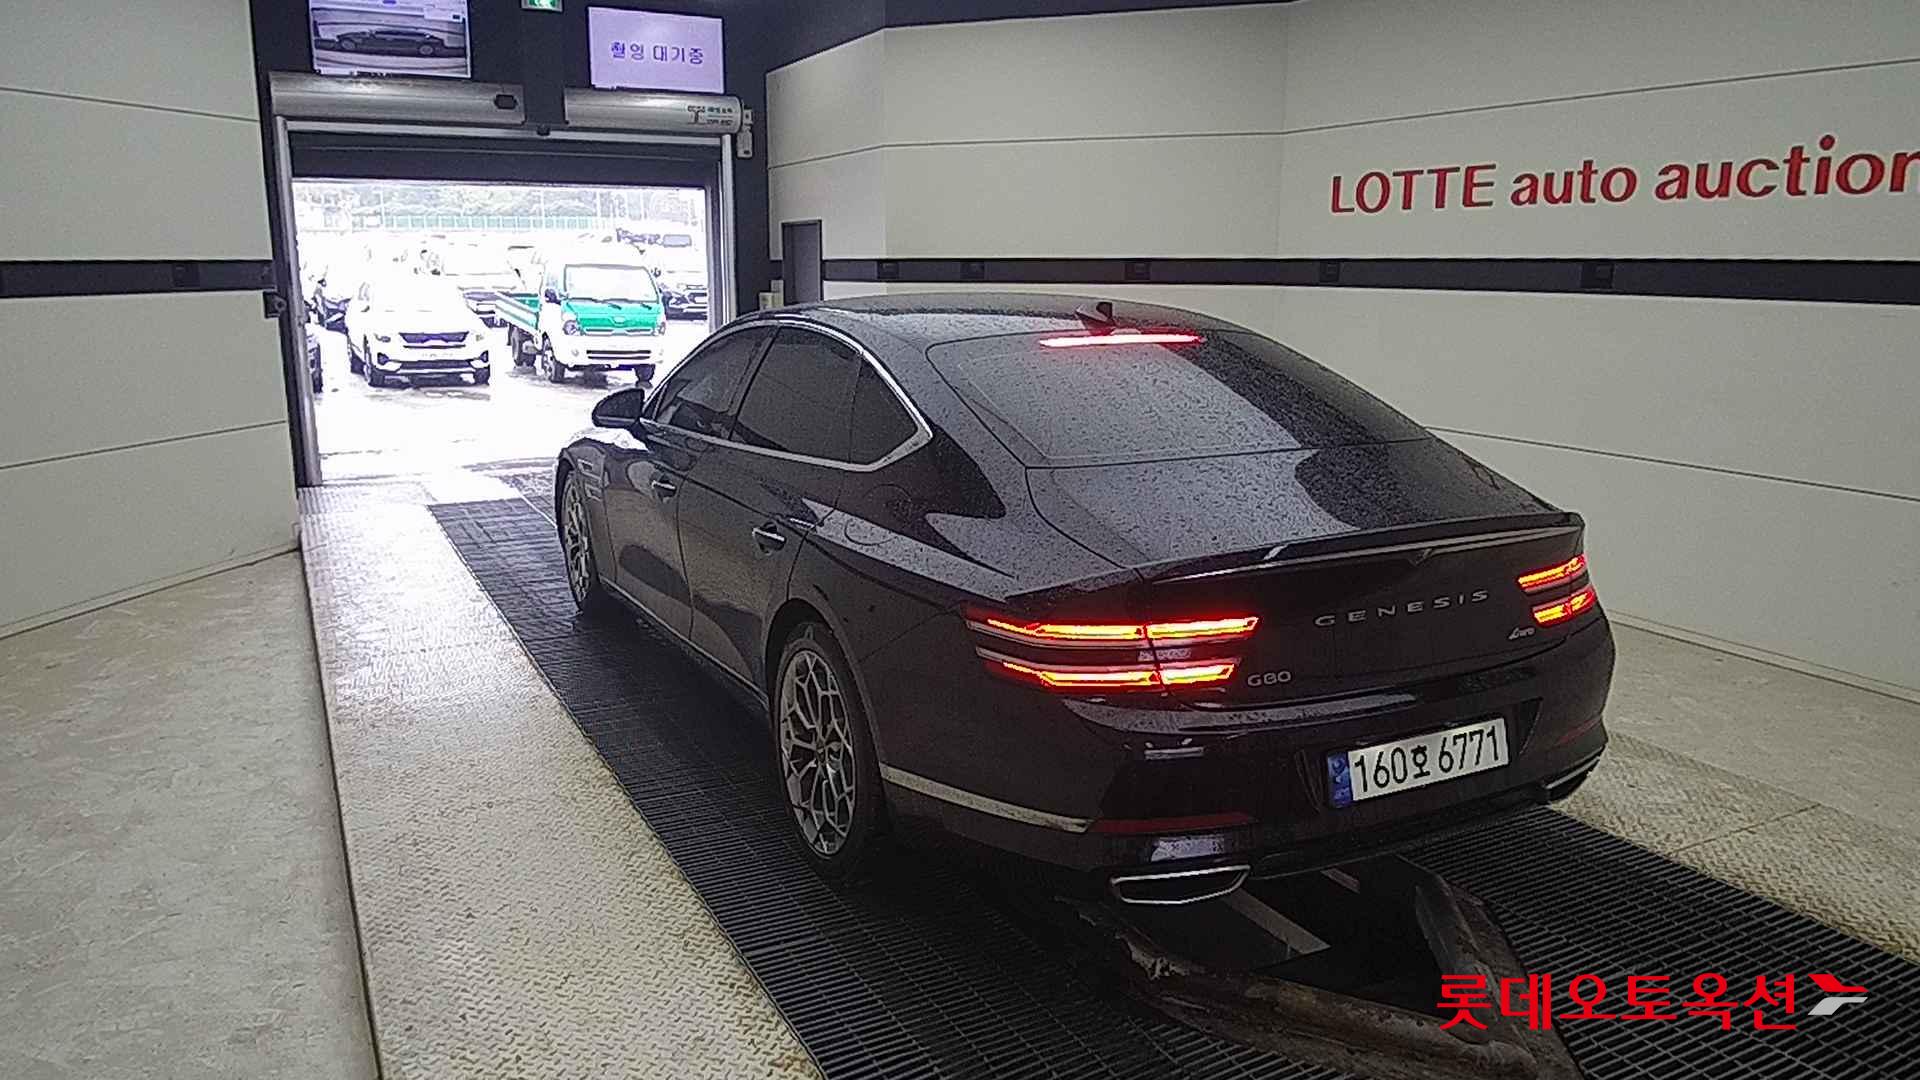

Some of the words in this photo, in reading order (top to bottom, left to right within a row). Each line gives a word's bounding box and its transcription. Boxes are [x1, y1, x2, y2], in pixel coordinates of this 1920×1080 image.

[653, 45, 704, 65] 대기중
[1331, 164, 1496, 213] LOTTE
[1510, 159, 1638, 206] auto
[1655, 134, 1920, 200] auction
[1314, 589, 1489, 627] GENESIS
[1247, 670, 1292, 687] G80
[1354, 745, 1430, 792] 160호
[1438, 725, 1499, 773] 6771
